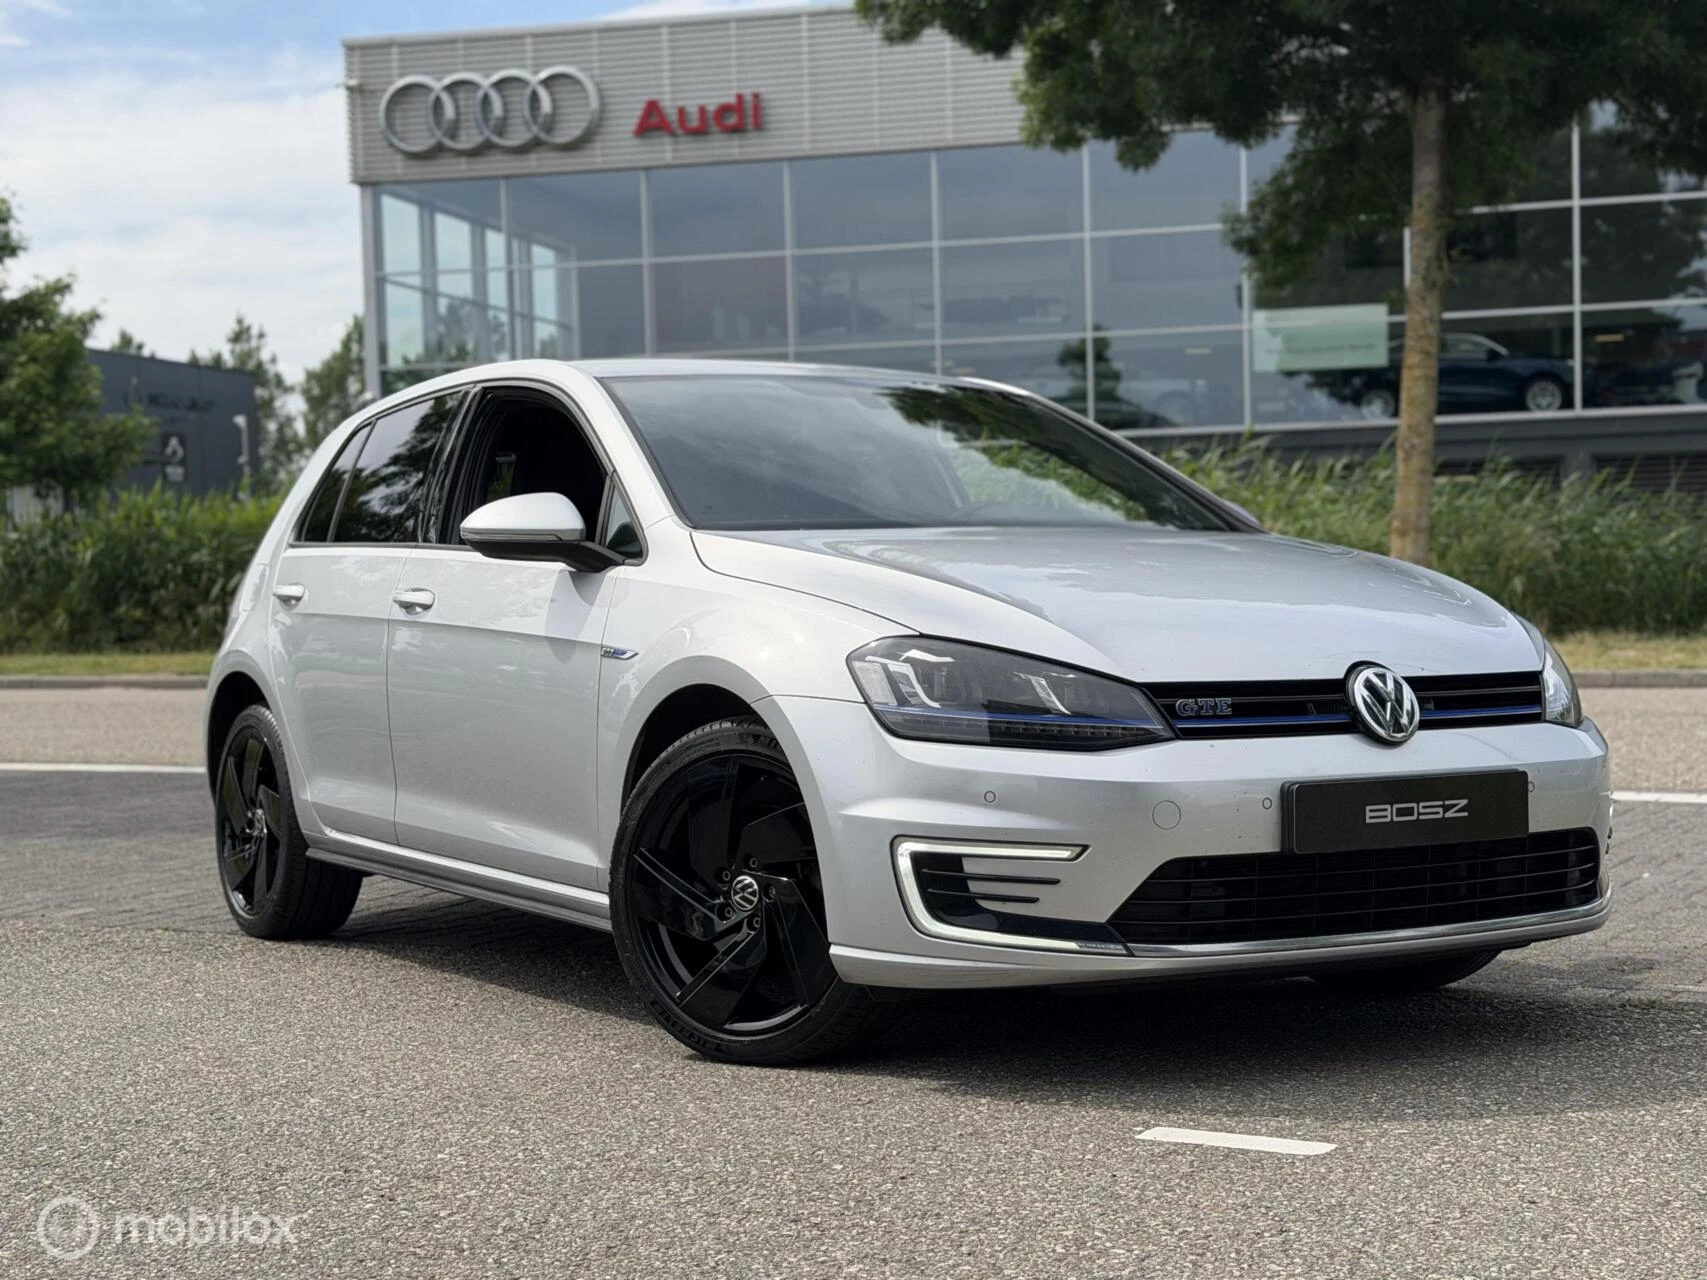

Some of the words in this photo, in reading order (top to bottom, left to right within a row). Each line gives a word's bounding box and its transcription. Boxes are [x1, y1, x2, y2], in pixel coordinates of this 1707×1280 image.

[633, 92, 763, 137] Audi
[1175, 697, 1233, 717] GTE
[1365, 799, 1469, 824] BOSZ
